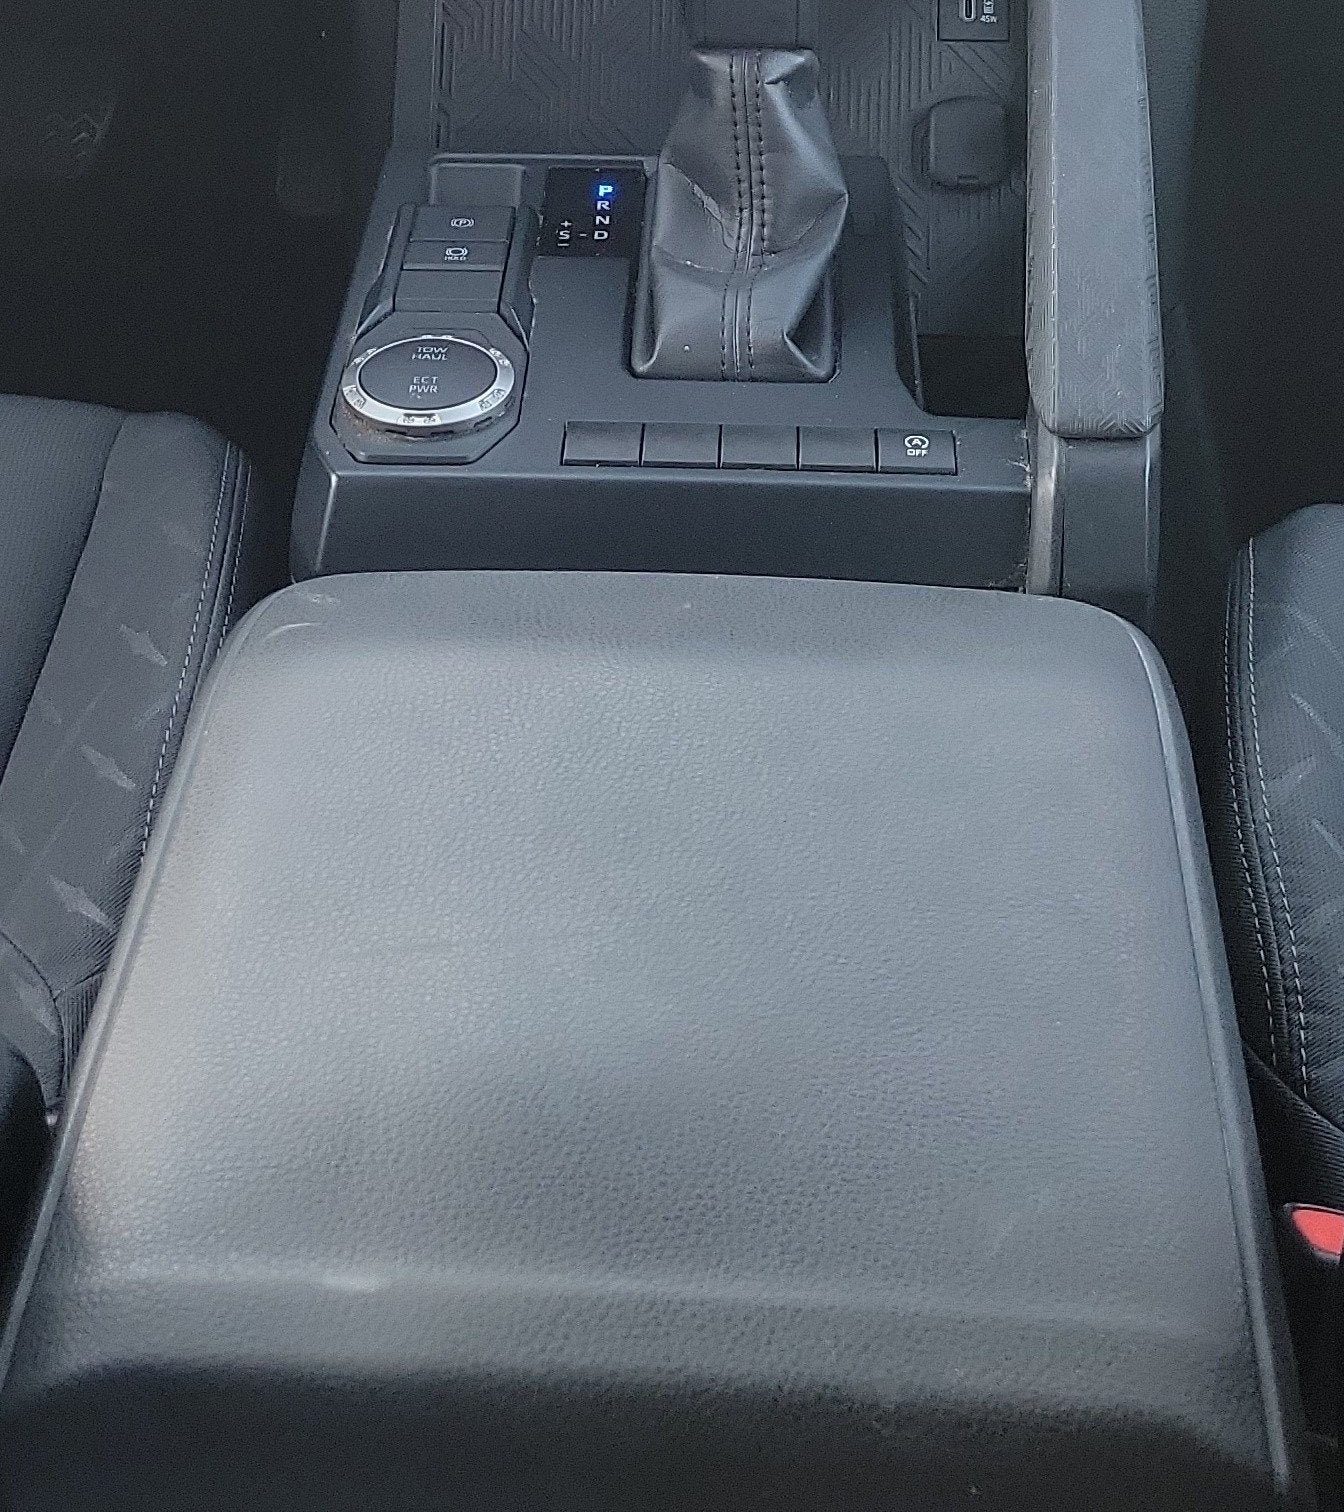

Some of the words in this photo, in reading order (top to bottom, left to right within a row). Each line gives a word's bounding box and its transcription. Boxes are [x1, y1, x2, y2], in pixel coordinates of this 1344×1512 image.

[980, 15, 998, 23] 45W
[599, 184, 613, 197] P
[597, 200, 611, 211] R
[596, 215, 610, 225] N
[558, 230, 571, 240] S
[593, 230, 609, 240] D
[417, 346, 449, 354] TOW
[413, 376, 439, 384] ECT
[409, 385, 438, 393] PWR
[906, 449, 928, 457] OFF
